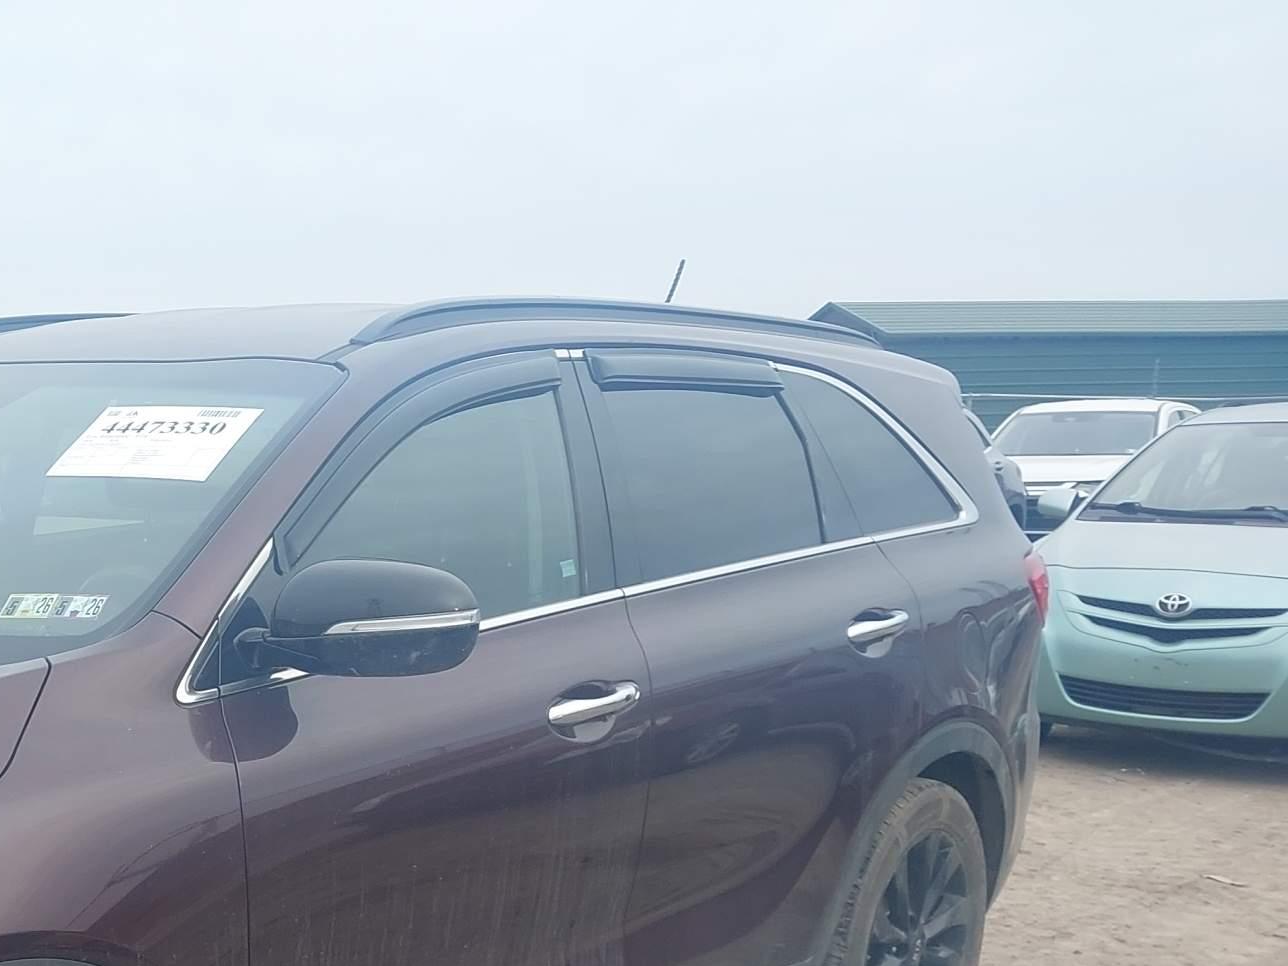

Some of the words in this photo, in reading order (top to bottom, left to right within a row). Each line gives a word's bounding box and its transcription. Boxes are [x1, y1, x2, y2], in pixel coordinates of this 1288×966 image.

[101, 421, 227, 435] 44473330
[35, 597, 55, 614] 26
[84, 598, 104, 616] 26
